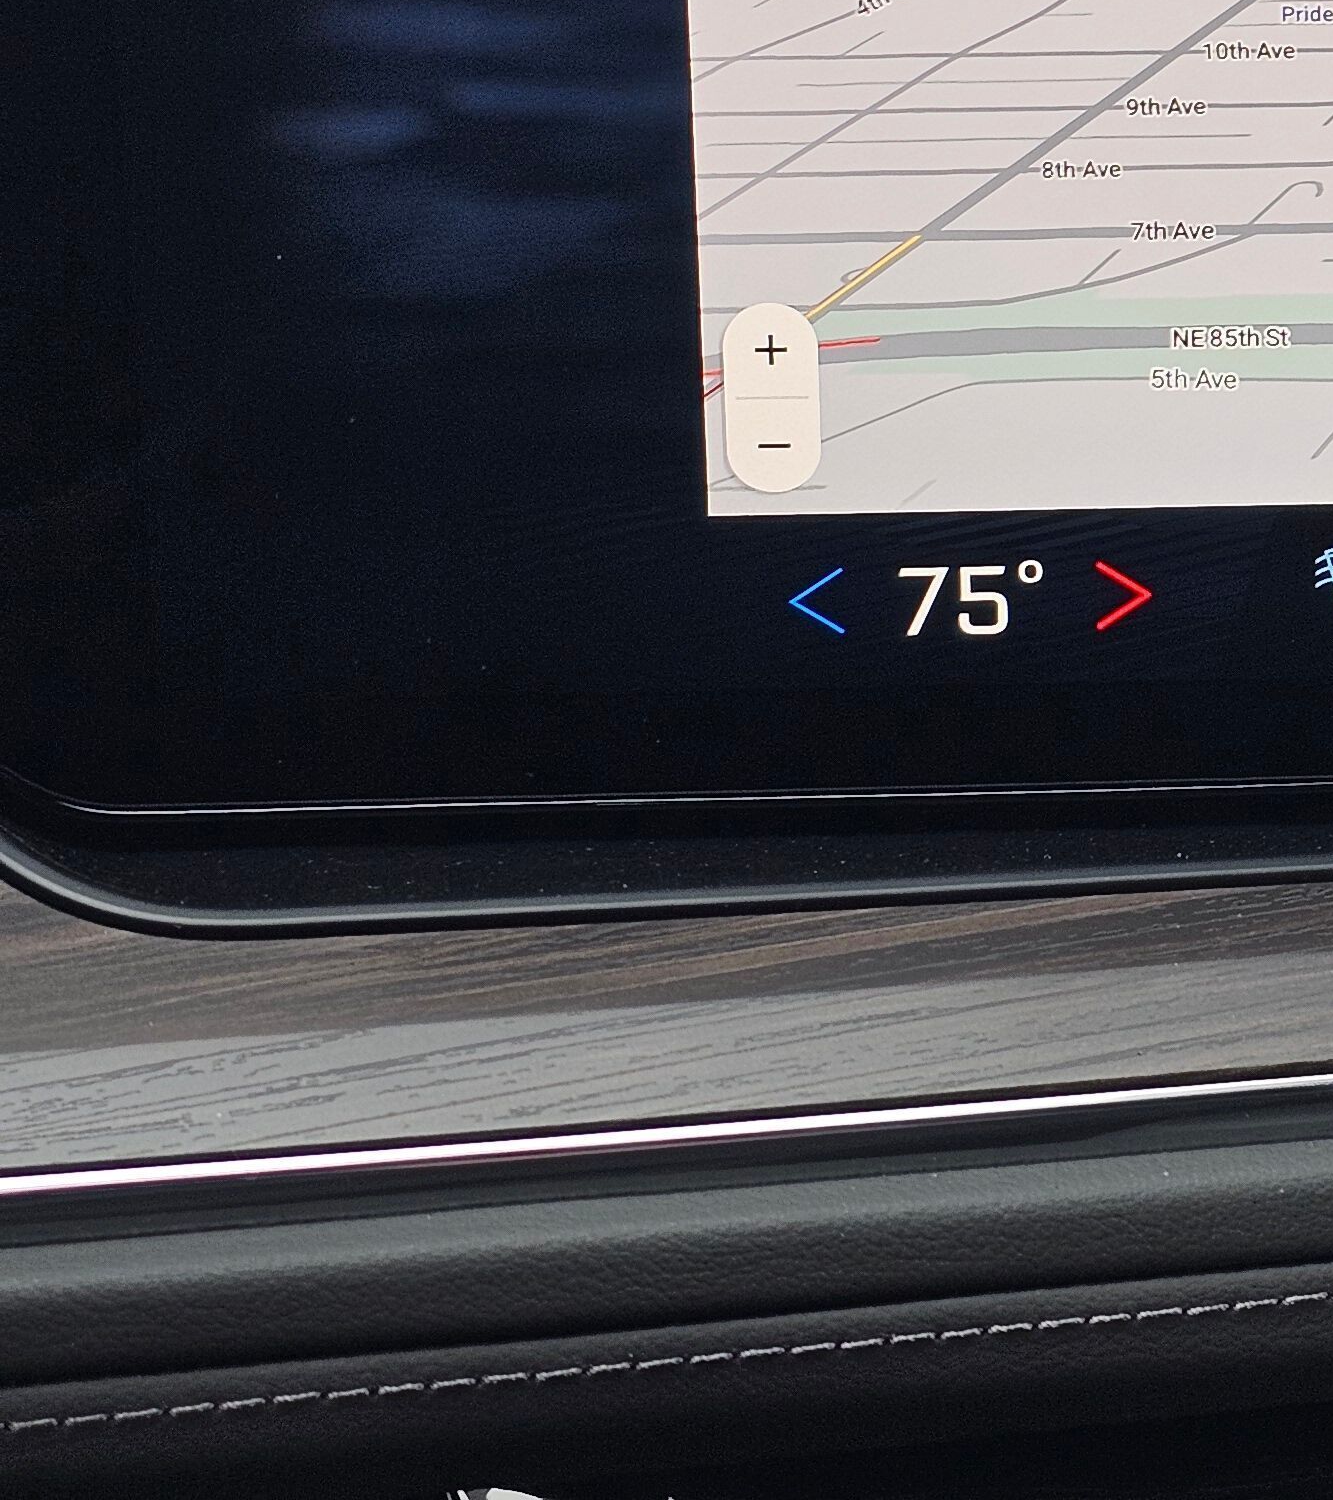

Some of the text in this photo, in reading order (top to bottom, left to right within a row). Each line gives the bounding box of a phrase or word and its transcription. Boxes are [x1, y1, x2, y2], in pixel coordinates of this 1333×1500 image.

[1283, 6, 1333, 22] Pride
[1203, 43, 1295, 59] 10th Ave
[1126, 99, 1206, 115] 9th Ave
[1042, 162, 1121, 178] 8th Ave
[1131, 222, 1215, 240] 7th Ave
[1172, 329, 1290, 347] NE 85th St
[1152, 371, 1237, 388] 5th Ave
[899, 559, 1044, 637] 75°
